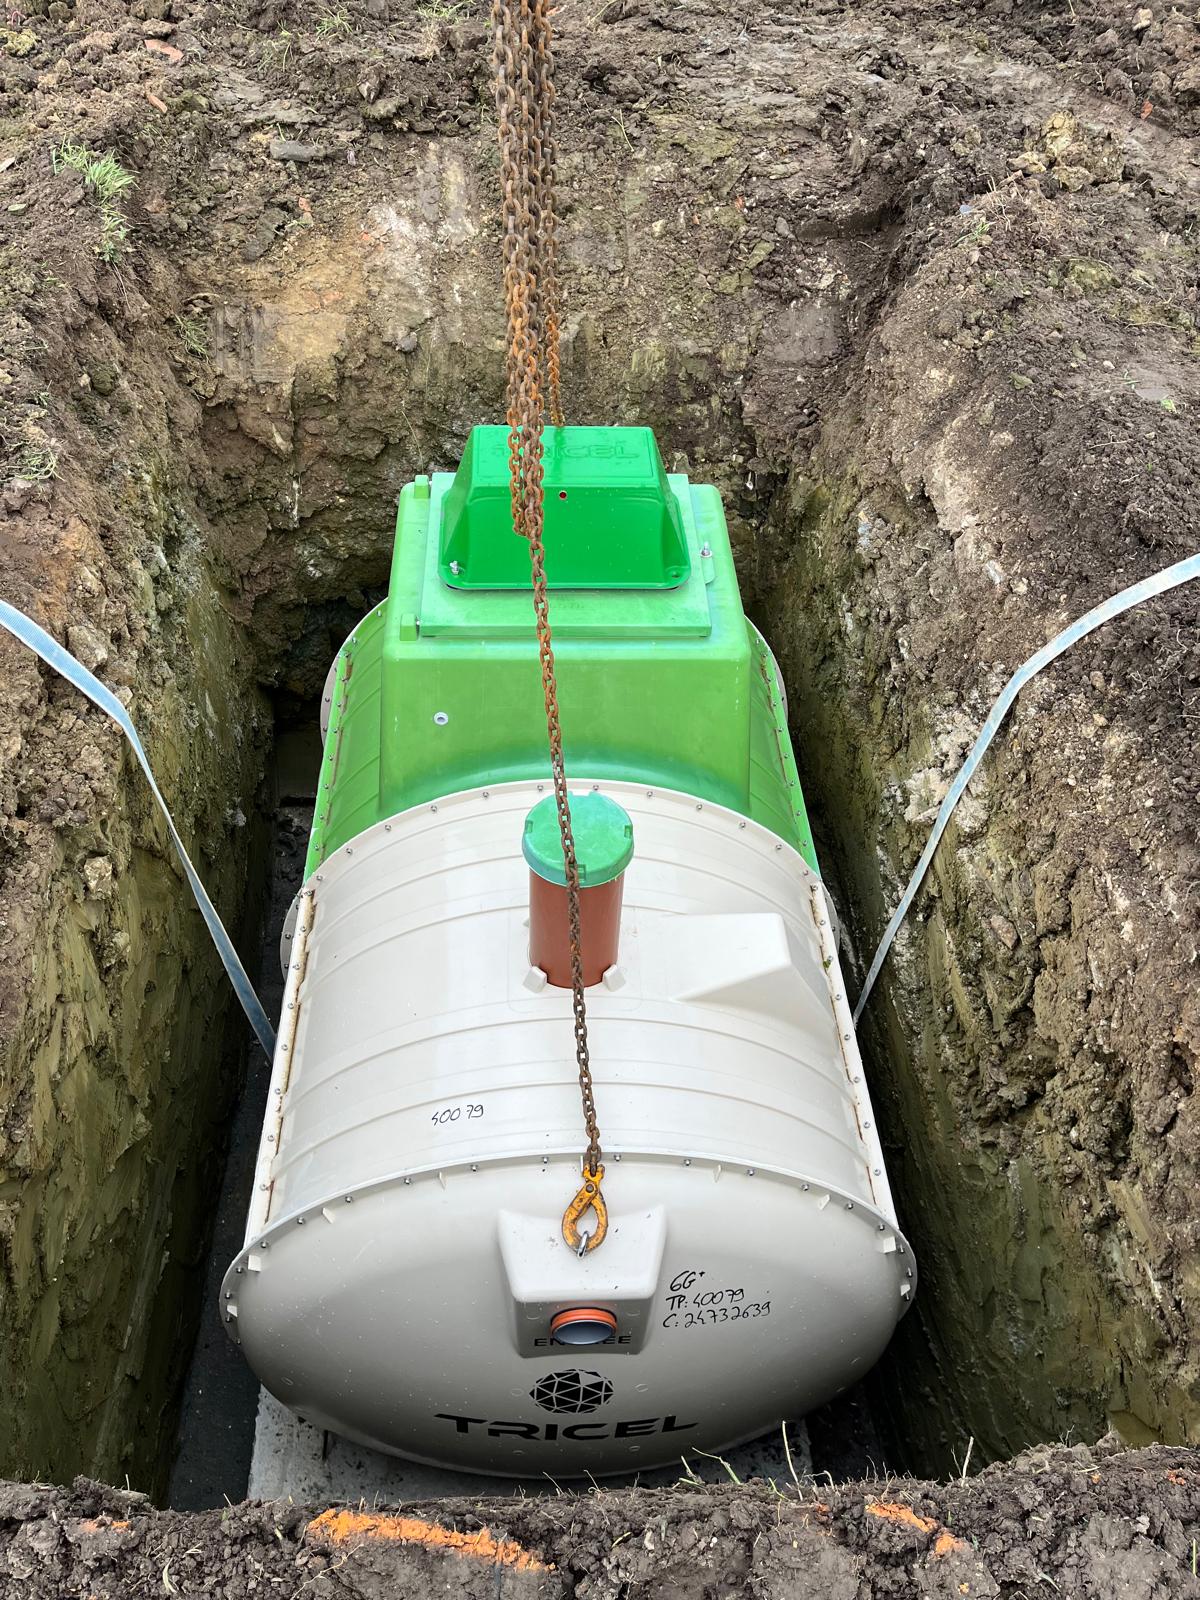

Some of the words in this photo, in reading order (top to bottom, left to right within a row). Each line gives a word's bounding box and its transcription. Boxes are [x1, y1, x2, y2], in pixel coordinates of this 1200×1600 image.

[692, 1288, 745, 1308] 40079
[684, 1301, 771, 1329] 24732639
[533, 1335, 632, 1347] ENEE
[433, 1413, 699, 1441] TRICEL
